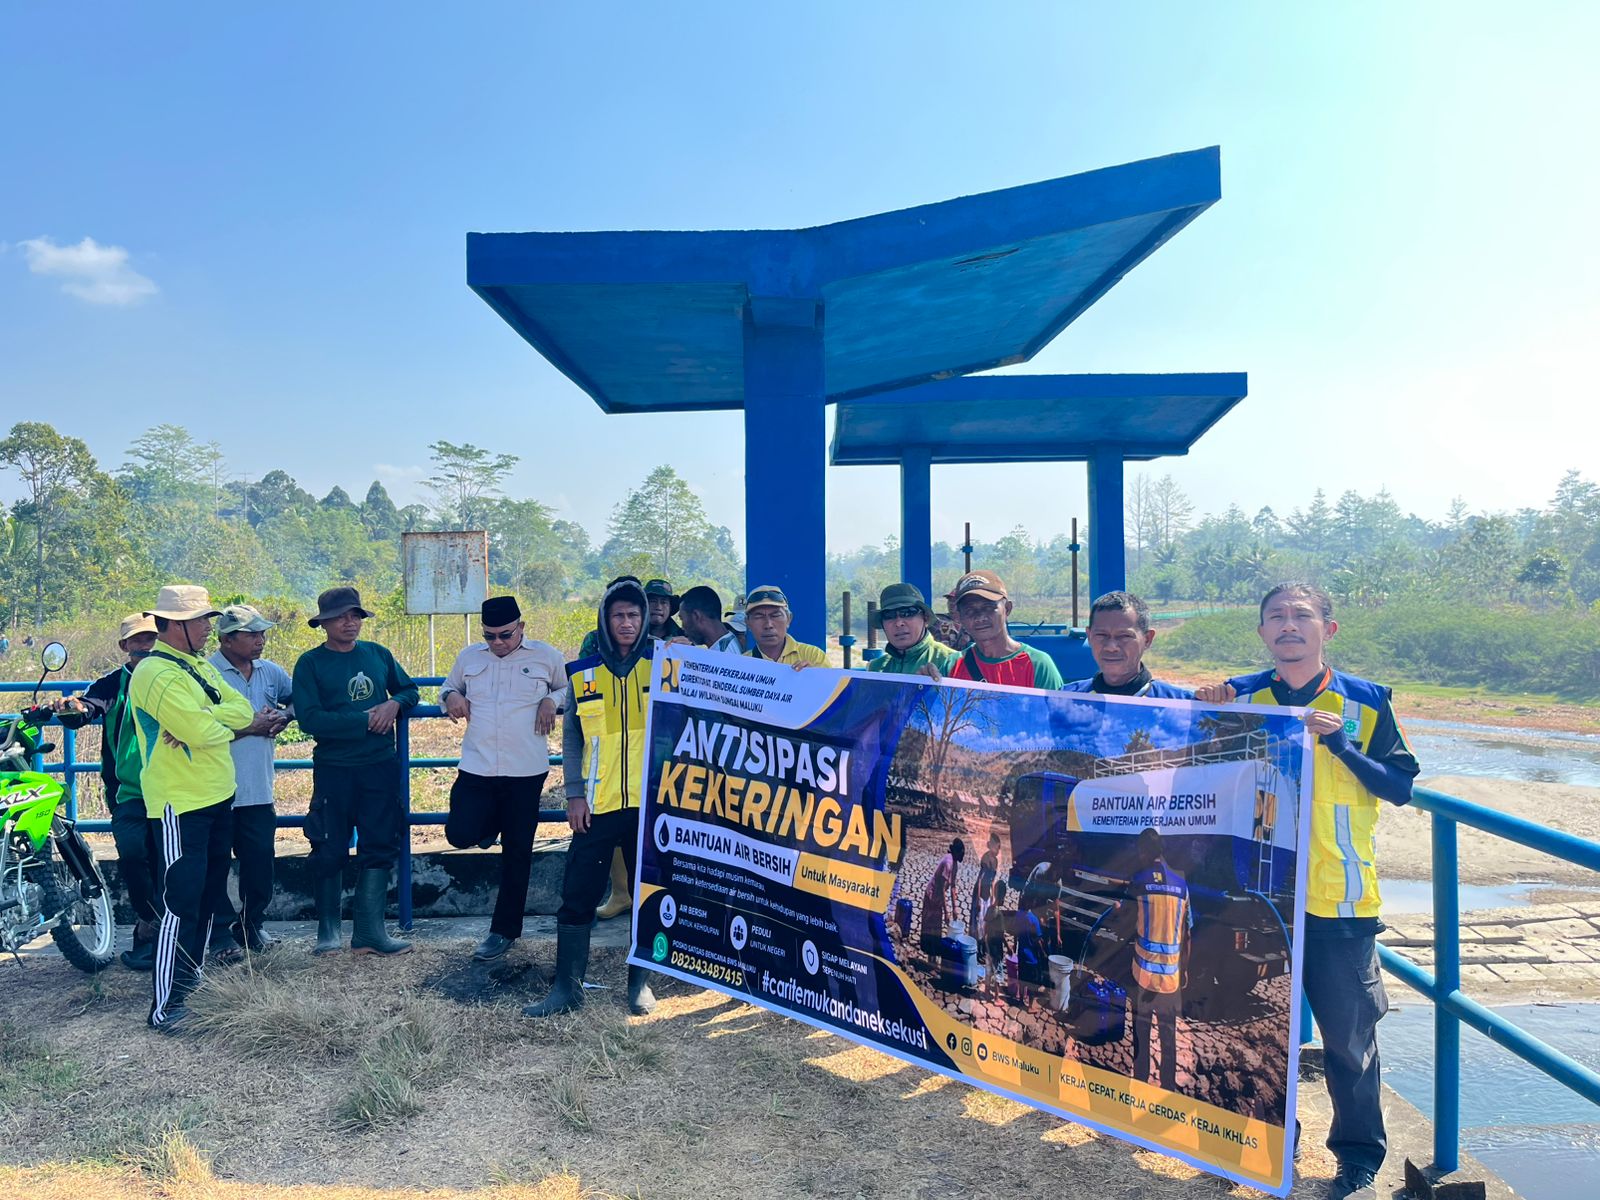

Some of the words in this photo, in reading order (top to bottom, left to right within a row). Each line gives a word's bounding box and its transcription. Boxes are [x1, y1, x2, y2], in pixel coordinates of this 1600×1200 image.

[719, 667, 755, 682] PEKERJAAN
[755, 674, 776, 686] UMUM
[712, 680, 738, 694] JENDERAL
[740, 685, 764, 698] SUMBER
[764, 690, 780, 702] DAYA
[781, 694, 792, 704] AIR
[739, 701, 763, 712] MALUKU
[673, 716, 850, 795] ANTISIPASI
[0, 786, 44, 805] KLX
[1092, 796, 1144, 810] BANTUAN
[1146, 795, 1166, 810] AIR
[1169, 793, 1216, 810] BERSIH
[656, 760, 902, 863] KEKERINGAN
[1092, 815, 1139, 826] KEMENTERIAN
[1140, 816, 1185, 827] PEKERJAAN
[1188, 814, 1216, 826] UMUM
[675, 827, 731, 855] BANTUAN
[733, 842, 750, 862] AIR
[752, 846, 791, 876] BERSIH
[673, 857, 696, 870] Bersama
[697, 863, 706, 873] kita
[707, 866, 725, 879] hadapi
[725, 873, 743, 882] musim
[801, 865, 827, 884] Untuk
[828, 870, 880, 898] Masyarakat
[679, 904, 688, 913] AIR
[688, 906, 707, 918] BERSIH
[695, 877, 728, 894] ketersediaan
[729, 887, 737, 896] air
[737, 889, 754, 901] bersih
[756, 896, 769, 907] untuk
[796, 912, 809, 925] yang
[810, 914, 823, 928] lebih
[693, 922, 720, 936] KEHIDUPAN
[751, 925, 772, 938] PEDULI
[688, 945, 705, 956] SATGAS
[705, 949, 726, 963] BENCANA
[750, 940, 767, 951] UNTUK
[767, 946, 786, 957] NEGERI
[671, 950, 743, 986] 082343487415
[822, 950, 838, 963] SIGAP
[839, 956, 868, 975] MELAYANI
[822, 965, 844, 980] SEPENUH
[845, 973, 857, 985] HATI
[762, 972, 927, 1050] #caritemukandaneksekusi
[992, 1051, 1010, 1065] BWS
[1011, 1058, 1039, 1075] Maluku
[1060, 1072, 1086, 1089] KERJA
[1088, 1082, 1116, 1101] CEPAT,
[1119, 1092, 1146, 1111] KERJA
[1148, 1102, 1188, 1125] CERDAS,
[1191, 1115, 1220, 1136] KERJA
[1222, 1127, 1258, 1149] IKHLAS
